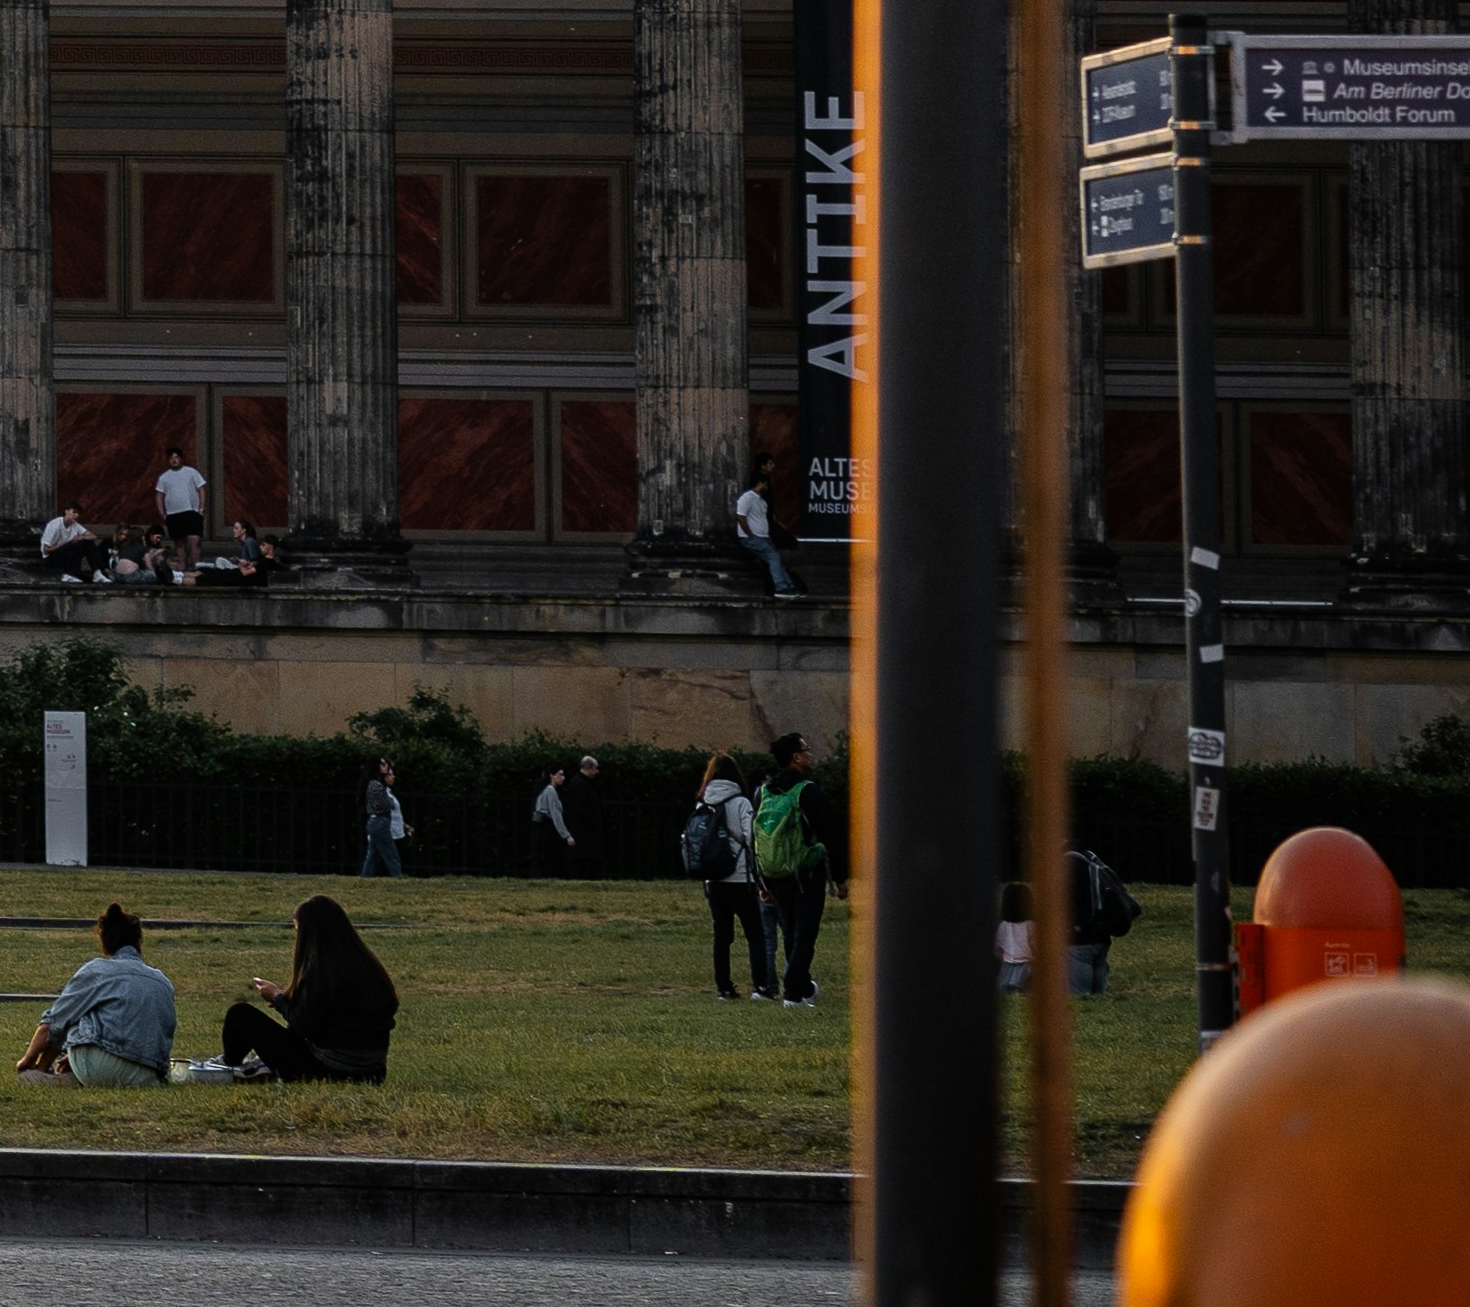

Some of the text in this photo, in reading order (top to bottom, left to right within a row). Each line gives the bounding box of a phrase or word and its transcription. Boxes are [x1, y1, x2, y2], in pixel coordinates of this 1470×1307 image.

[1343, 58, 1470, 75] Museumsinse
[1333, 83, 1365, 99] Am
[1370, 82, 1439, 99] Berliner
[1302, 107, 1455, 123] Humboldt Forum
[803, 89, 869, 384] ANTIKE
[808, 457, 872, 477] ALTES
[809, 481, 872, 501] MUSE
